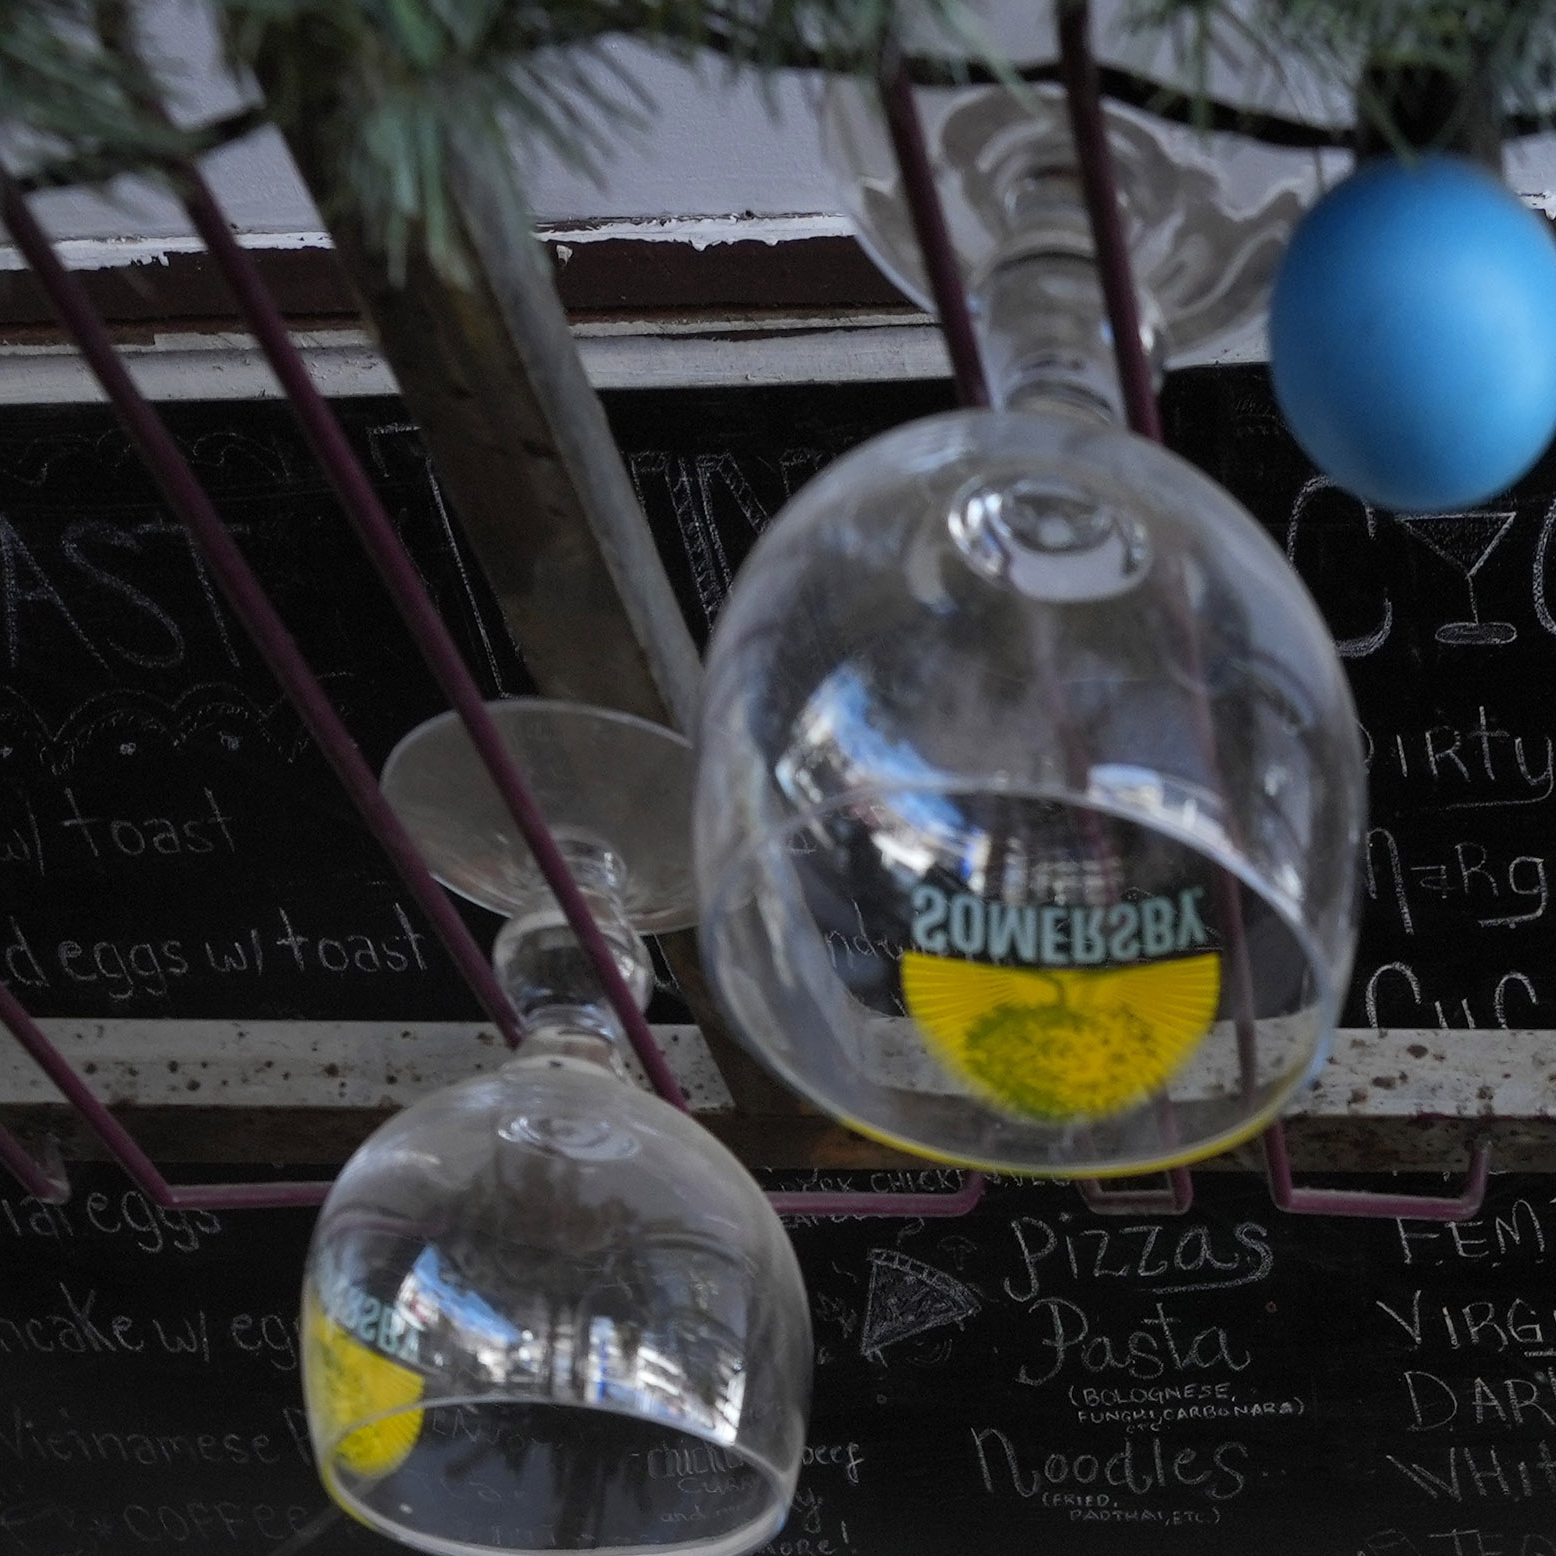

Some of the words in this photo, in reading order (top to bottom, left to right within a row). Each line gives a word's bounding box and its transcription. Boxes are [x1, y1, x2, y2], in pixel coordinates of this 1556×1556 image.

[277, 905, 429, 972] toast
[1004, 1210, 1274, 1303] Pizzas
[1016, 1299, 1253, 1387] Pasta
[970, 1424, 1250, 1501] Noodles
